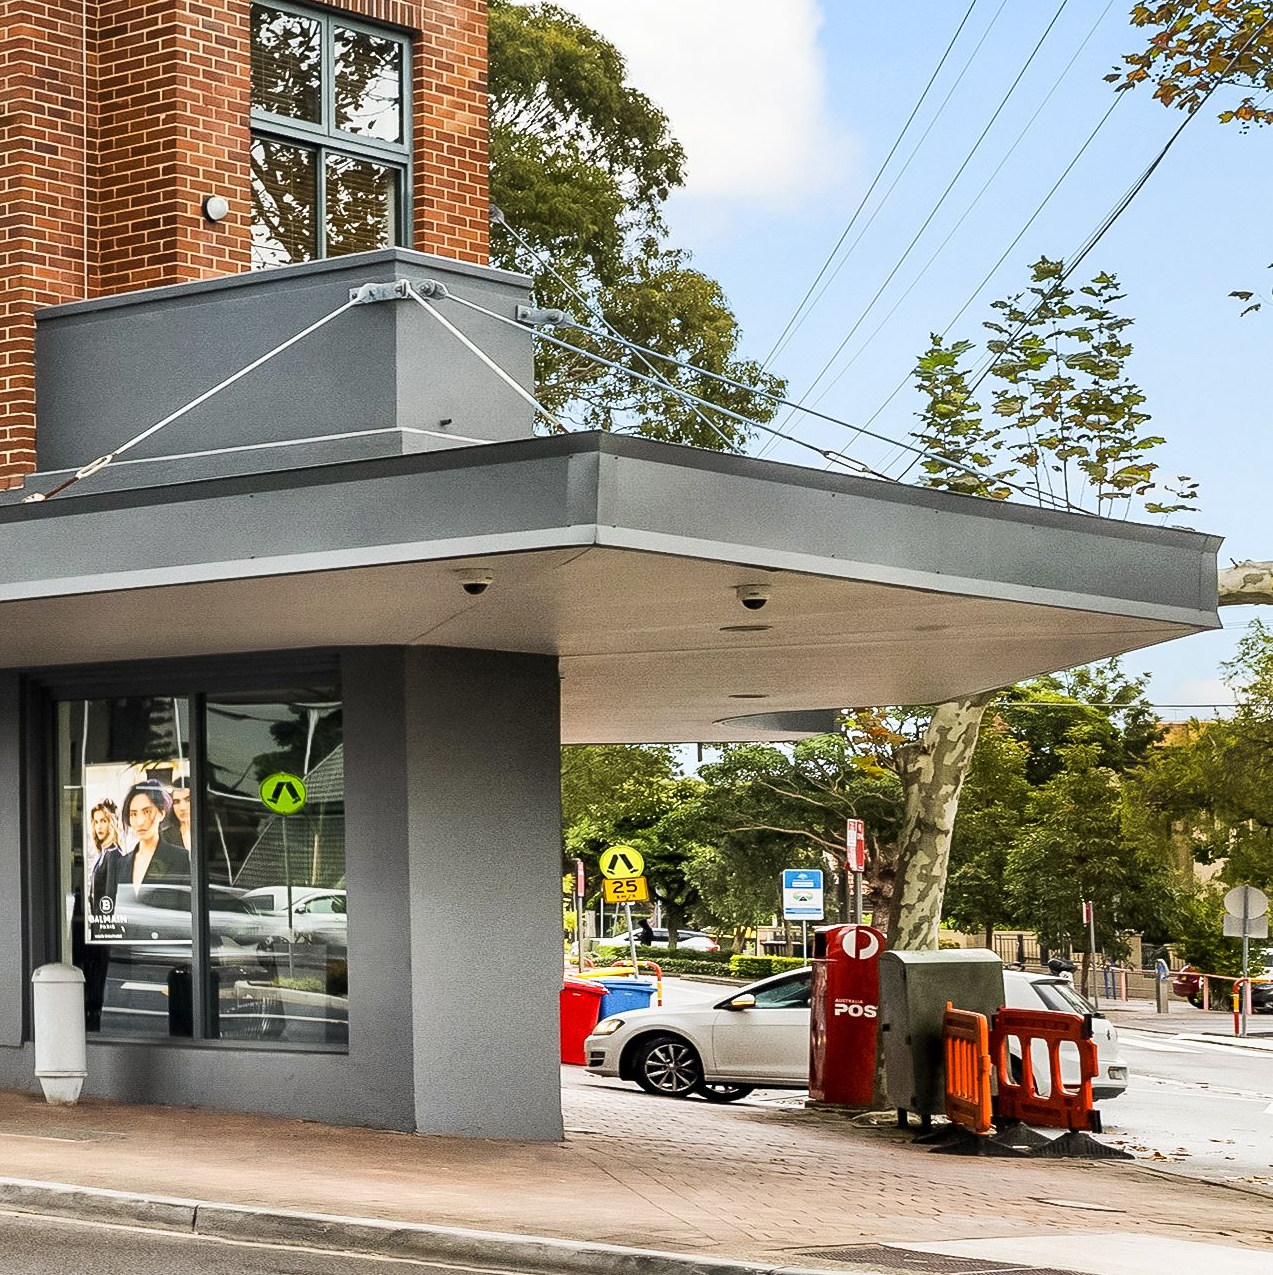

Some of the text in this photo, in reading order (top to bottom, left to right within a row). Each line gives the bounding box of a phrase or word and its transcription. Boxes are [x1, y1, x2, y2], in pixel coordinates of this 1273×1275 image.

[612, 880, 637, 893] 25
[101, 899, 111, 911] B
[88, 914, 128, 924] BALMAIN
[834, 1003, 879, 1018] POS
